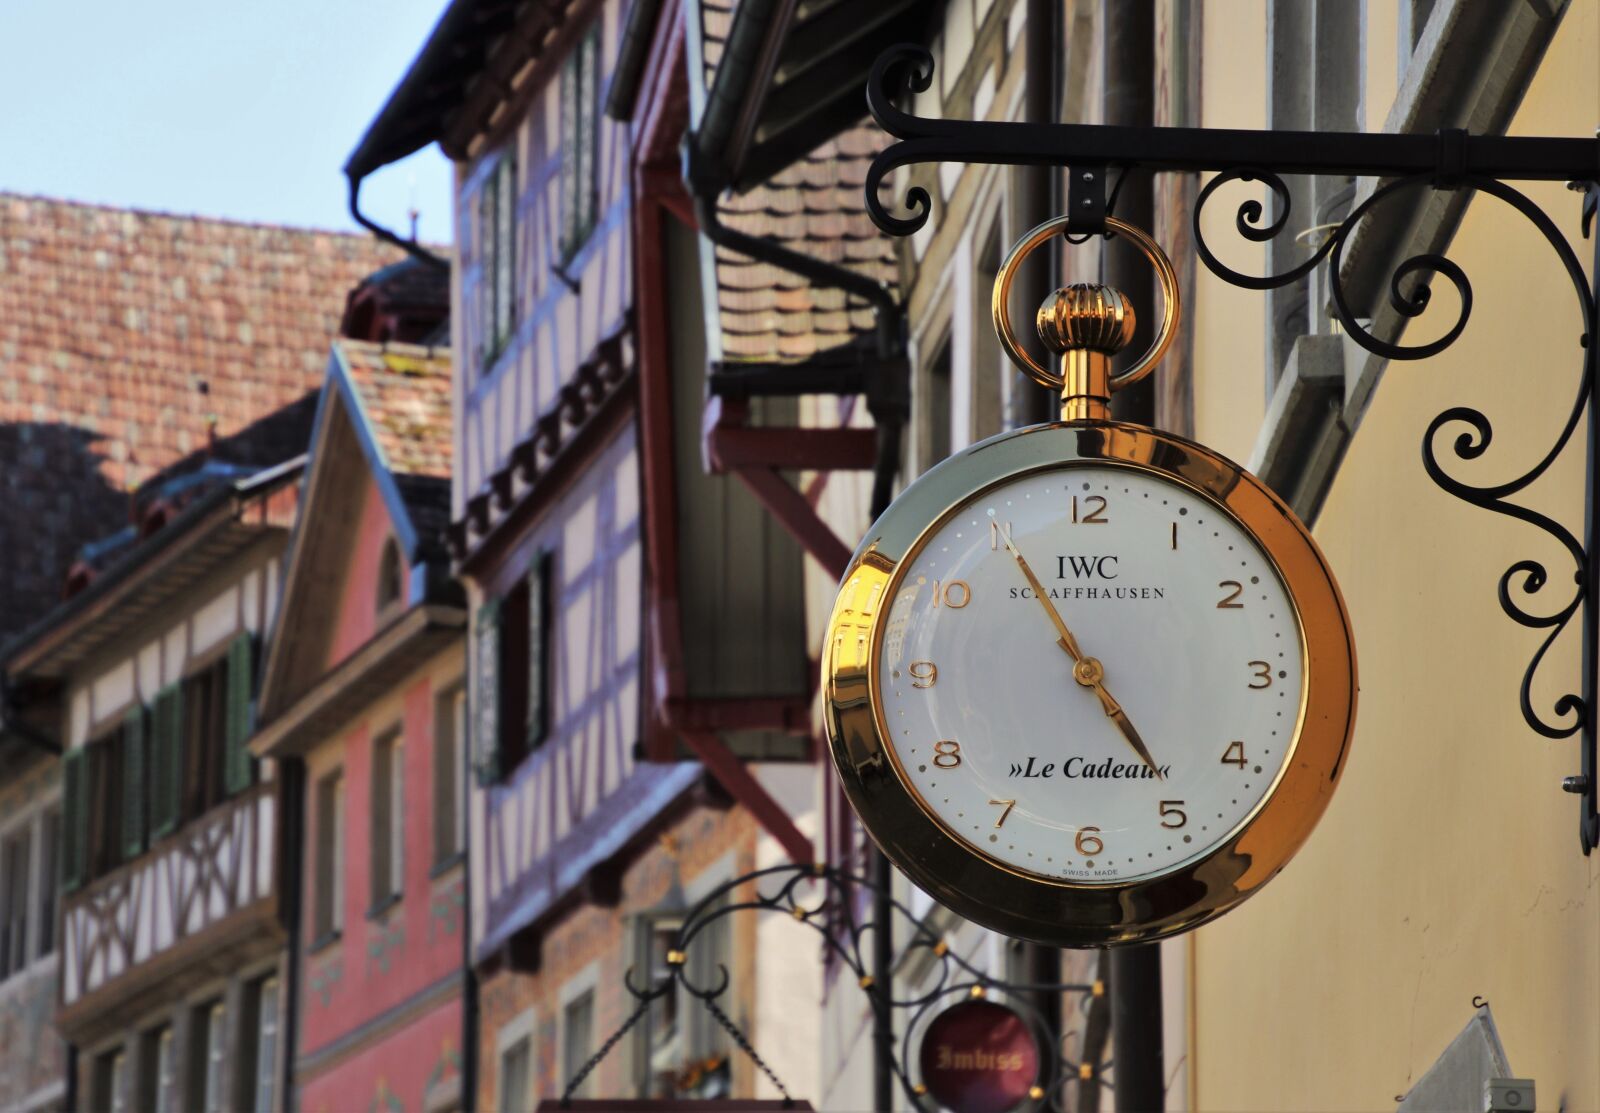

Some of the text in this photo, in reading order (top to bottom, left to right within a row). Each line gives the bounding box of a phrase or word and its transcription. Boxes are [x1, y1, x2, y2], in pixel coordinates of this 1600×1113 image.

[1070, 495, 1109, 524] 12
[1171, 521, 1178, 551] 1
[1056, 555, 1119, 579] IWC
[932, 579, 971, 609] 10
[1009, 587, 1165, 599] SCAFFHAUSEN
[1216, 580, 1245, 609] 2
[908, 661, 938, 689] 9
[1247, 660, 1272, 689] 3
[932, 740, 962, 769] 8
[1220, 741, 1248, 770] 4
[989, 799, 1016, 829] 7
[1160, 800, 1187, 830] 5
[1074, 826, 1104, 856] 6
[1062, 869, 1118, 877] SWISS MADE
[936, 1045, 1024, 1071] Imbiss
